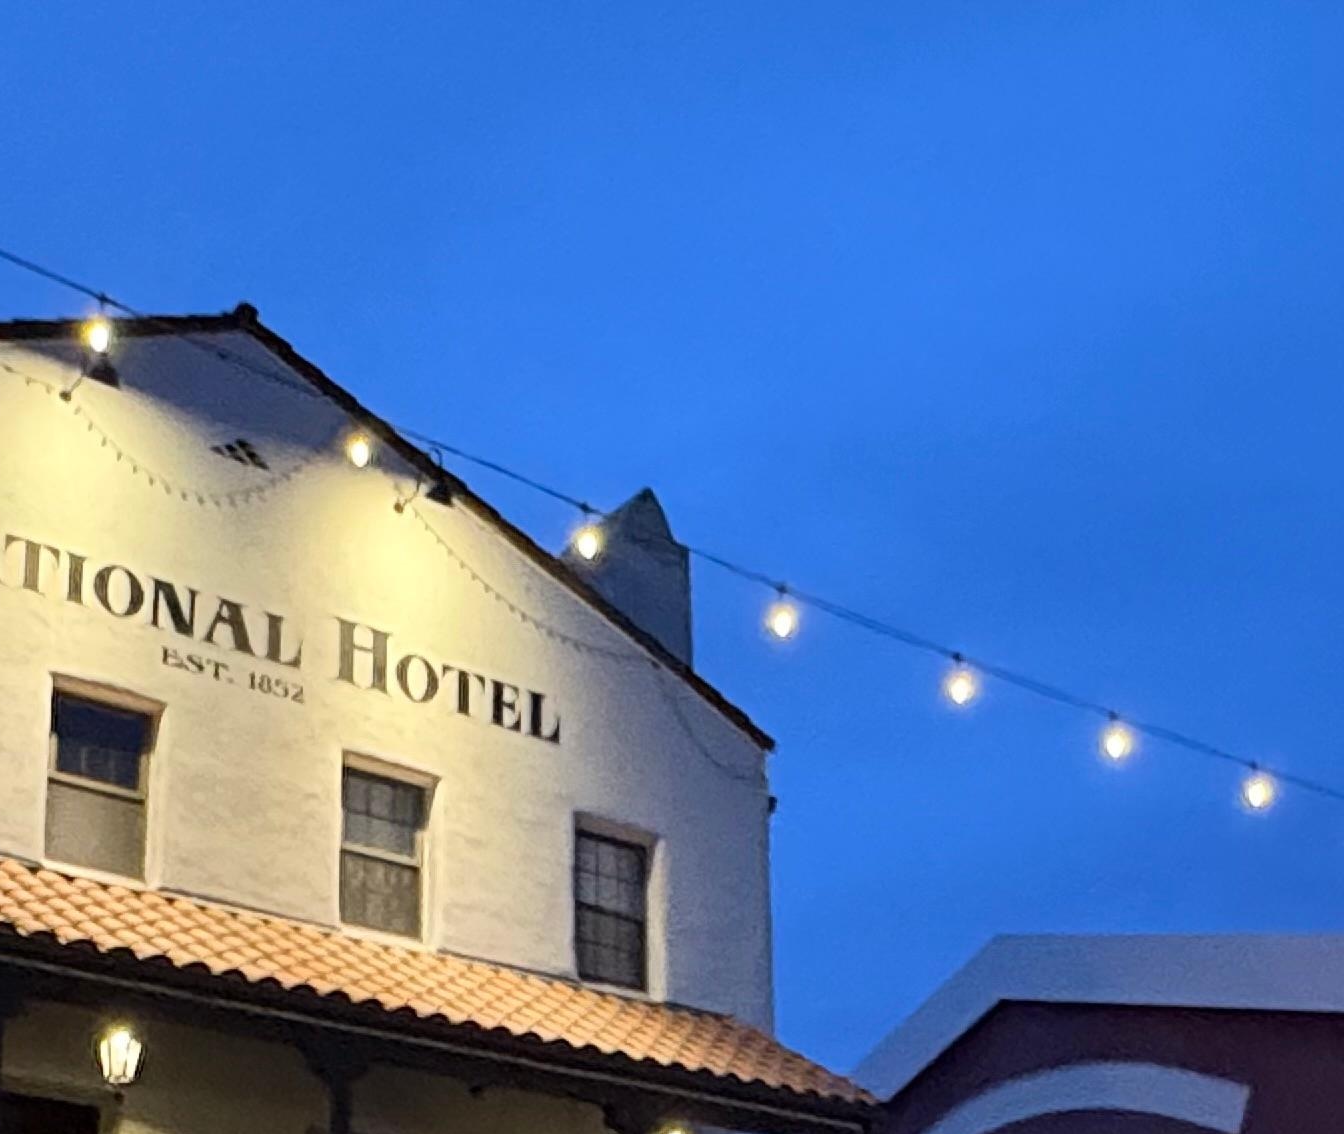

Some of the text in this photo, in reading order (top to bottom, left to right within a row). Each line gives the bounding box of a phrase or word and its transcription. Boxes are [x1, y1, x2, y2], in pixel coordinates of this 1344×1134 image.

[161, 643, 304, 705] EST. 1852
[334, 617, 562, 745] HOTEL
